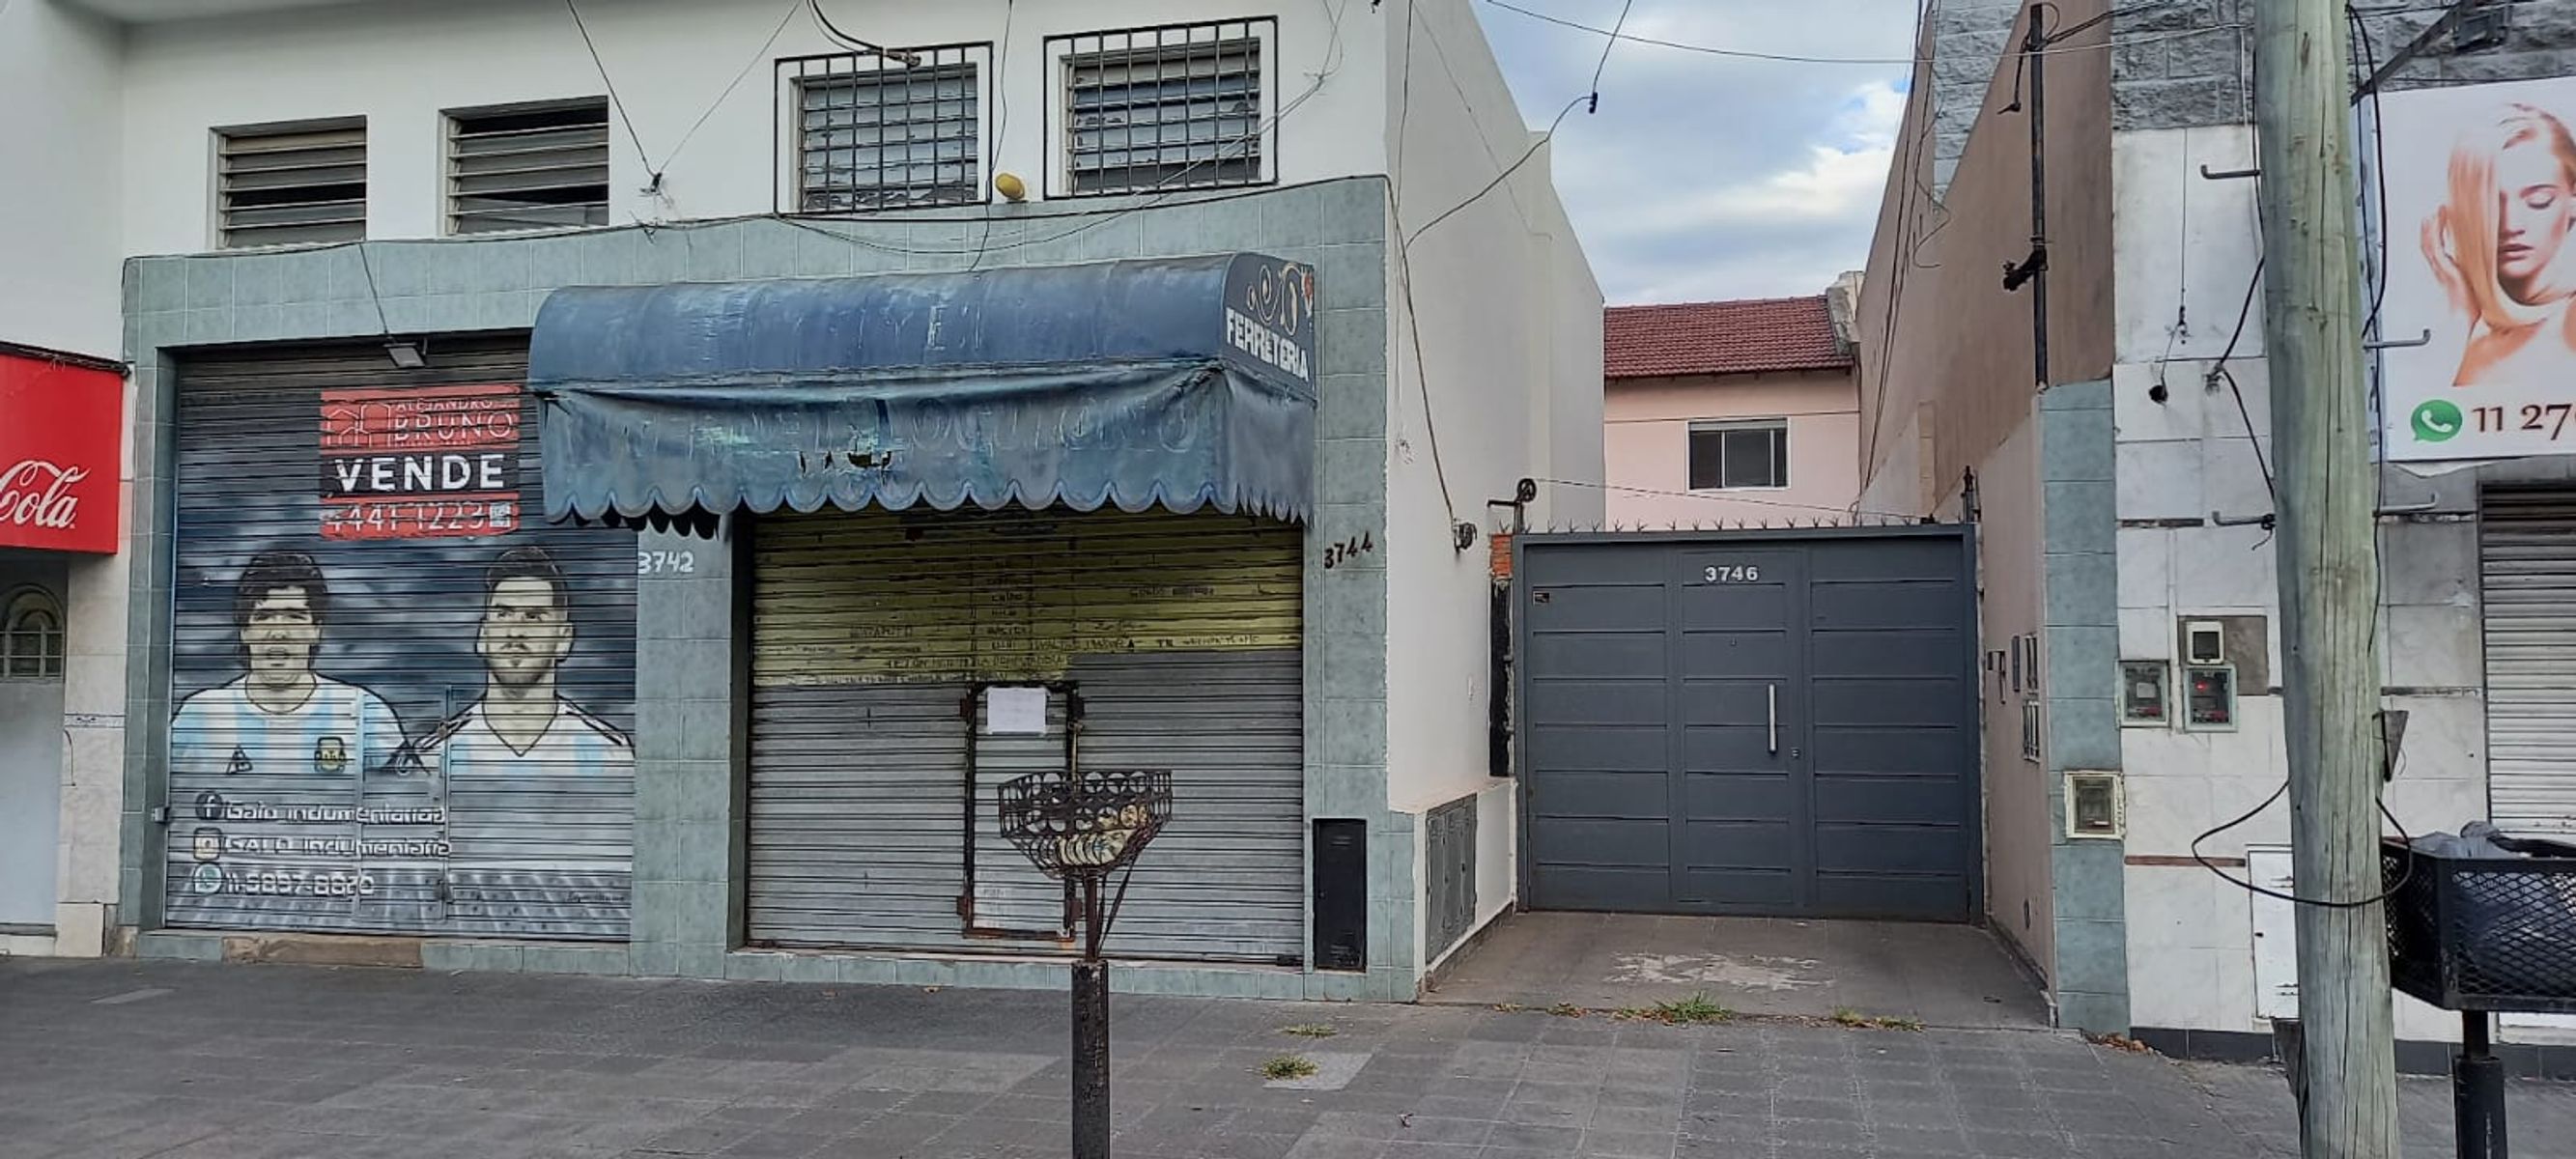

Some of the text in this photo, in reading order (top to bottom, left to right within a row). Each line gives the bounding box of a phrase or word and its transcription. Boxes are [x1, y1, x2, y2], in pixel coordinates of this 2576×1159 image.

[1226, 307, 1309, 382] FERRETERIA
[394, 410, 513, 441] BRUNO
[2472, 403, 2576, 441] 11 27
[334, 454, 505, 493] VENDE
[637, 551, 694, 575] 3742
[1324, 530, 1373, 569] 3744
[1705, 566, 1758, 581] 3746
